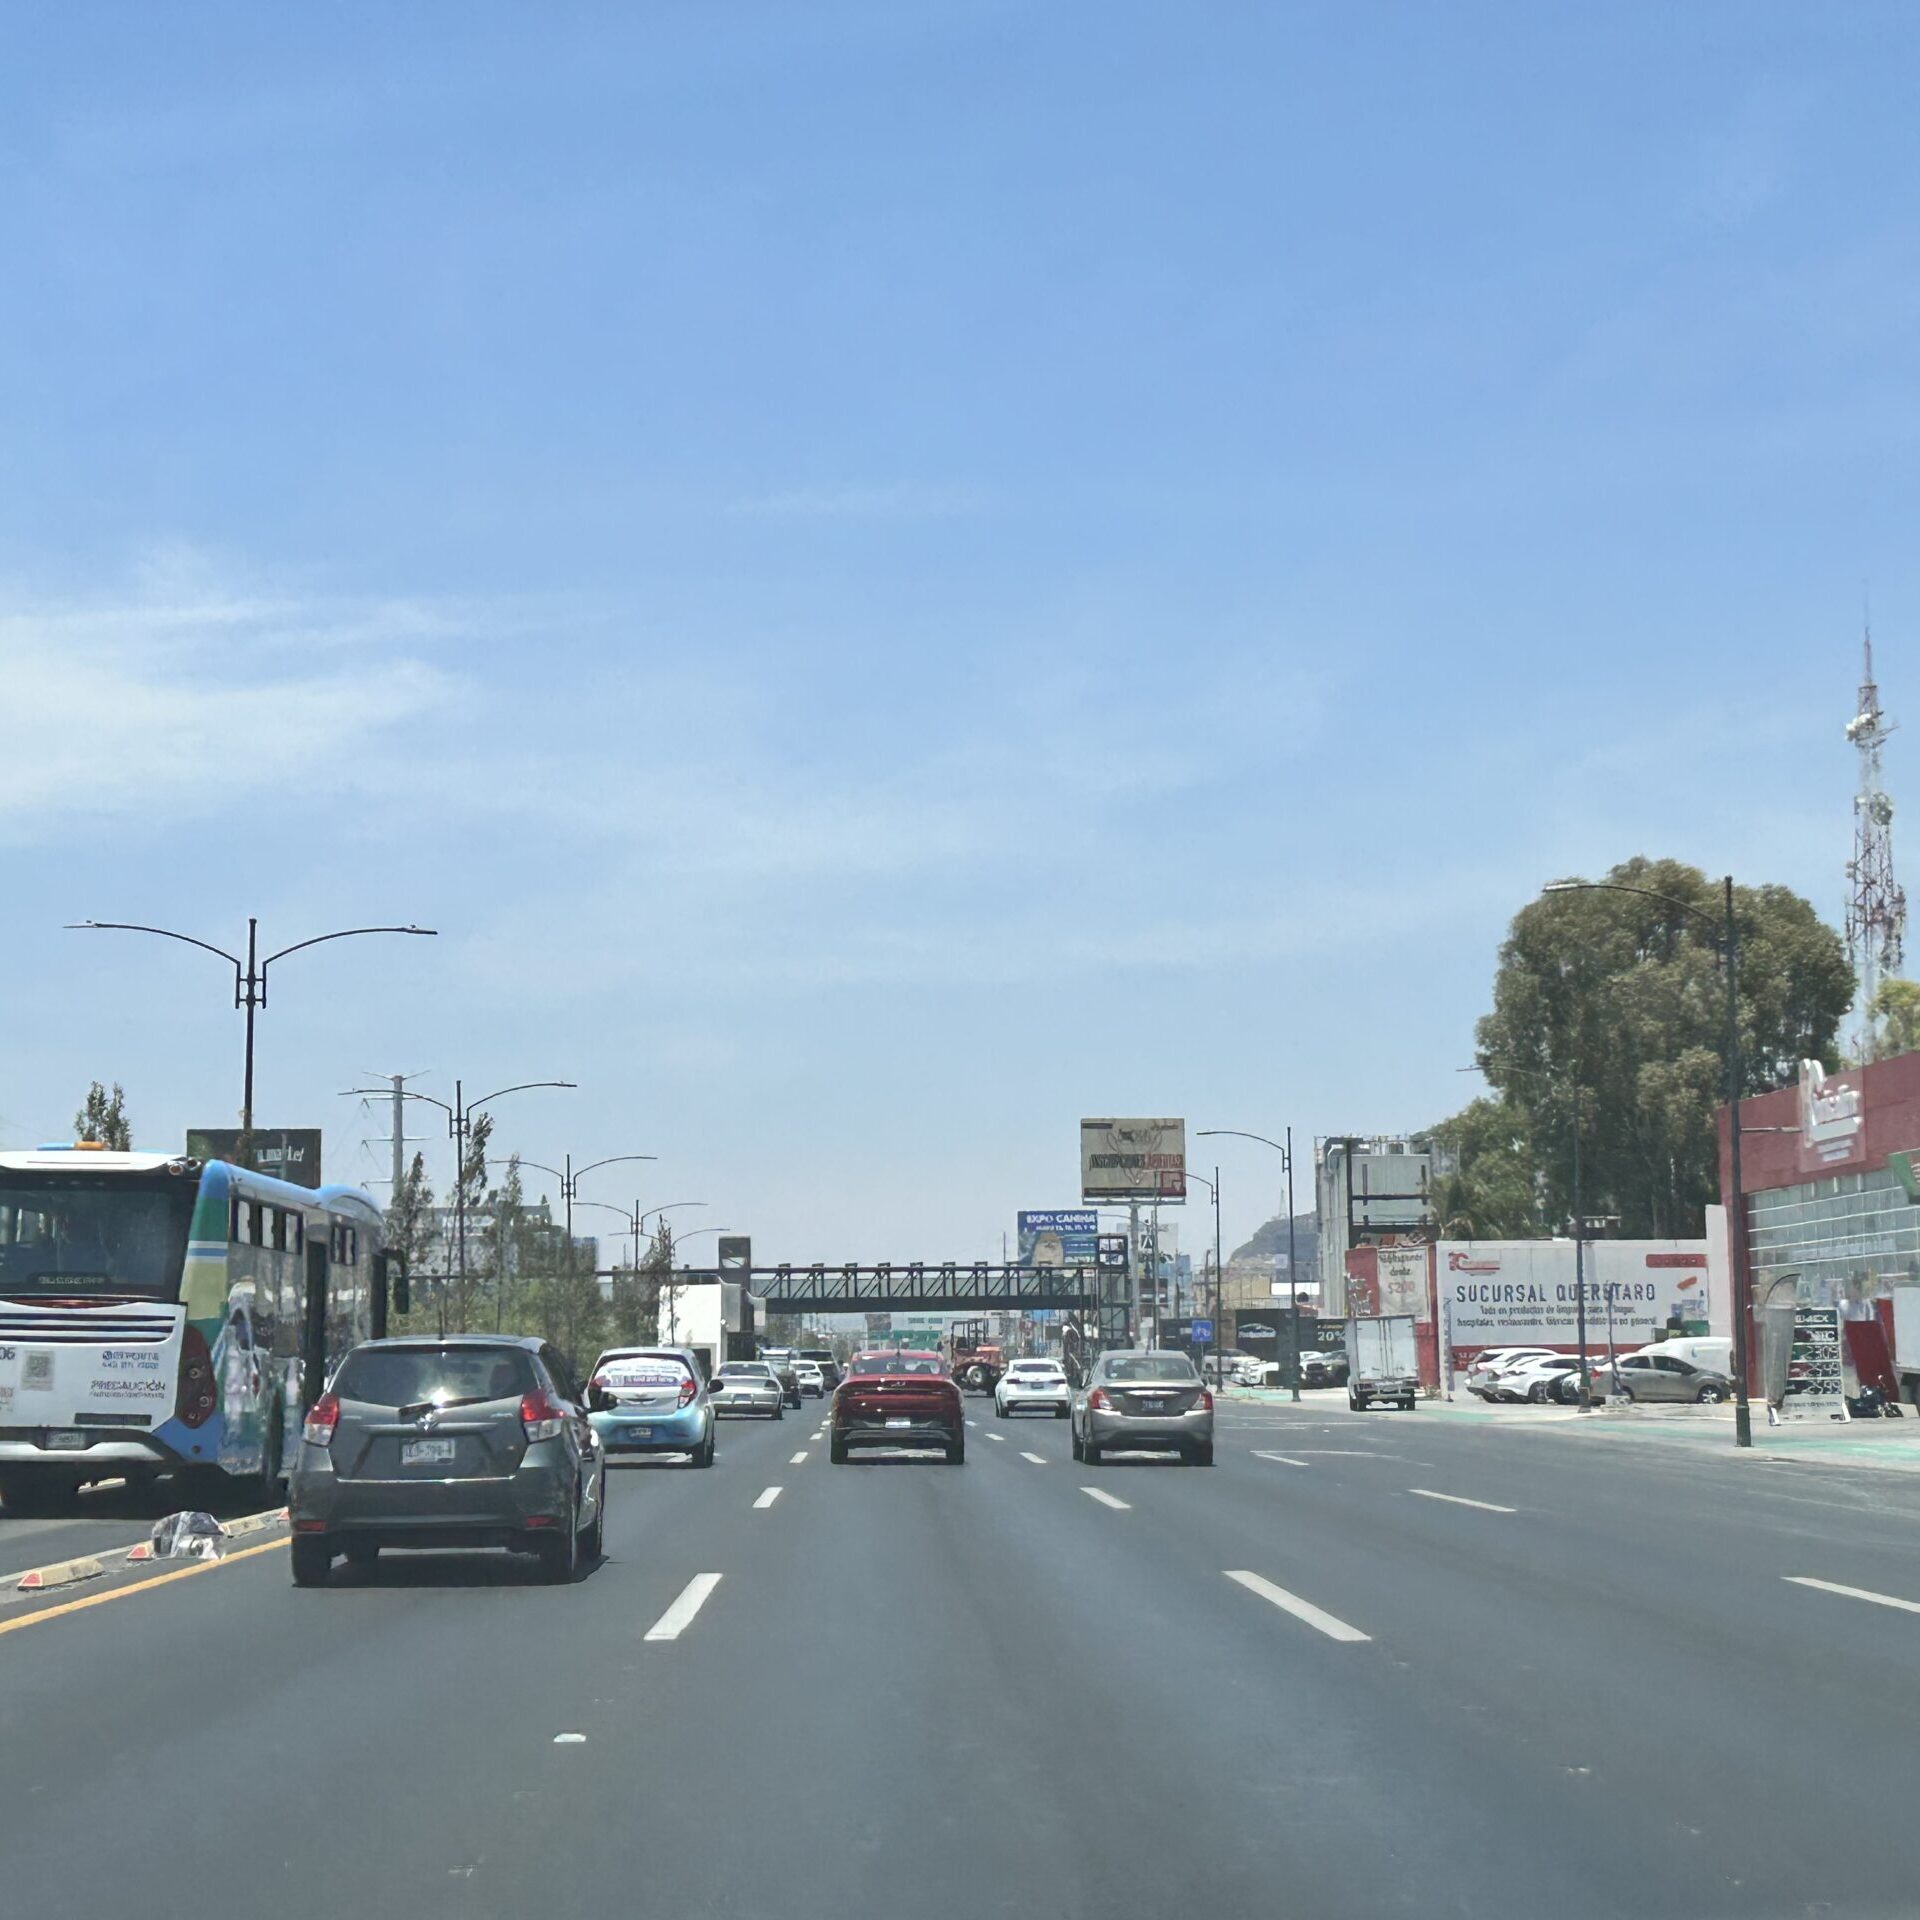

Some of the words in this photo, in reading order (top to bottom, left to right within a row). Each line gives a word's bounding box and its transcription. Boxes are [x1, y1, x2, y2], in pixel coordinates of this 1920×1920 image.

[1026, 1214, 1054, 1224] EXPO
[1056, 1213, 1096, 1223] CANINA
[1456, 1284, 1547, 1303] SUCURSAL
[1556, 1280, 1655, 1302] QUERÉTARO
